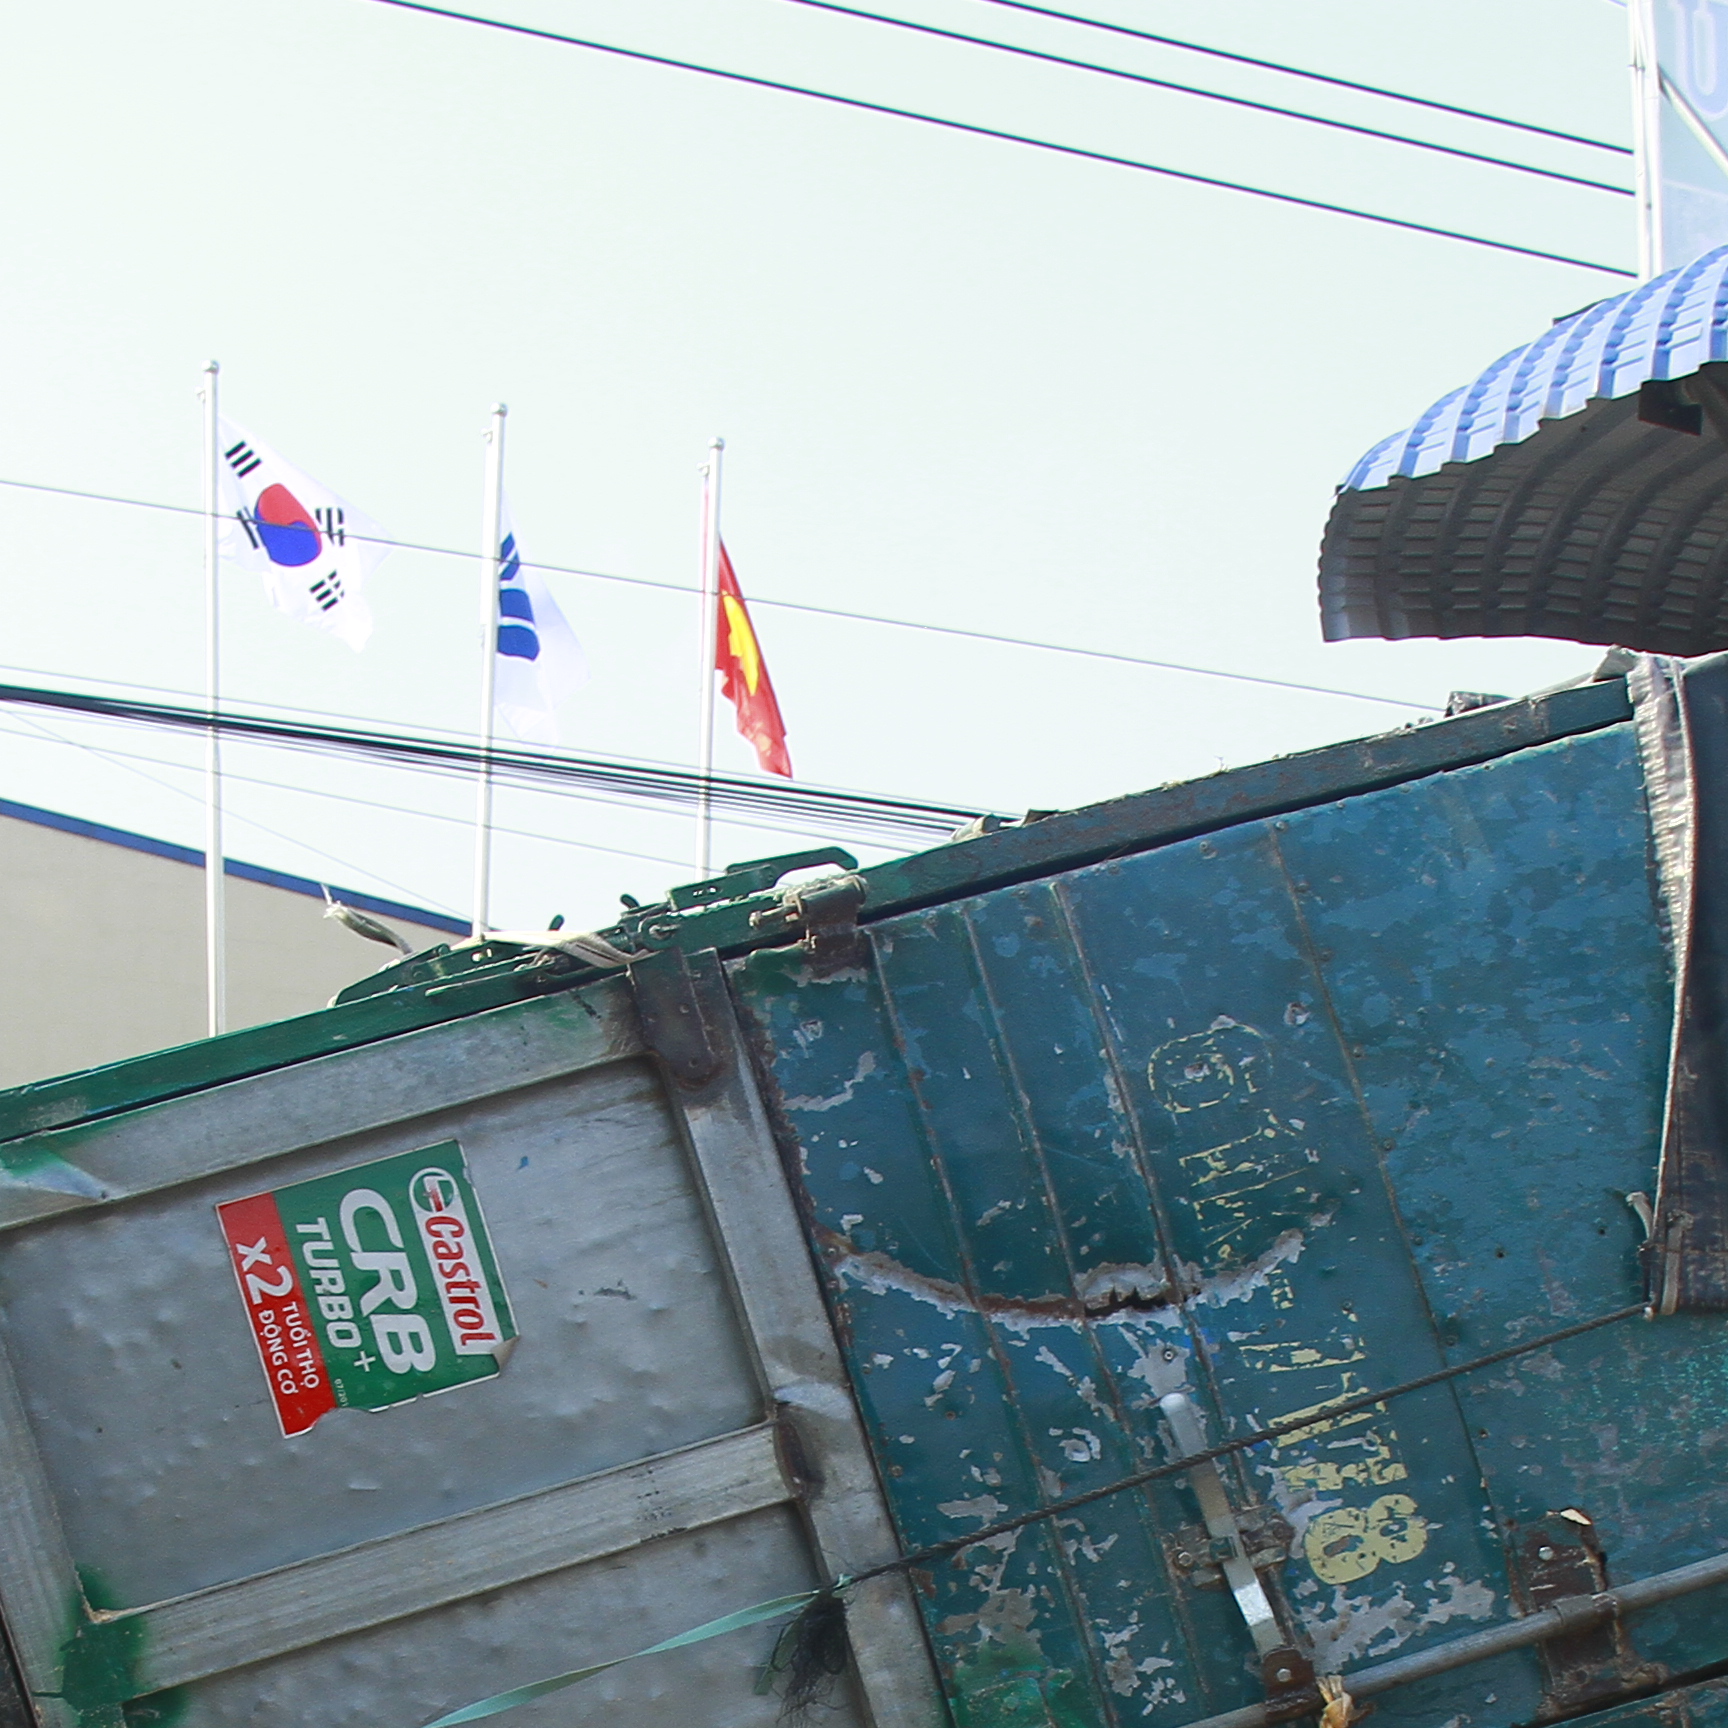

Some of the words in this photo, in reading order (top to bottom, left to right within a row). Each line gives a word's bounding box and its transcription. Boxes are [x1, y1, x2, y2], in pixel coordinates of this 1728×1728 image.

[234, 1236, 294, 1305] x2
[338, 1188, 437, 1375] CRB
[423, 1215, 498, 1347] Castrol
[257, 1309, 289, 1367] ĐỘNG
[276, 1368, 300, 1395] CƠ
[281, 1301, 312, 1348] TUỔI
[296, 1347, 320, 1389] THỌ
[333, 1378, 350, 1407] 07/201
